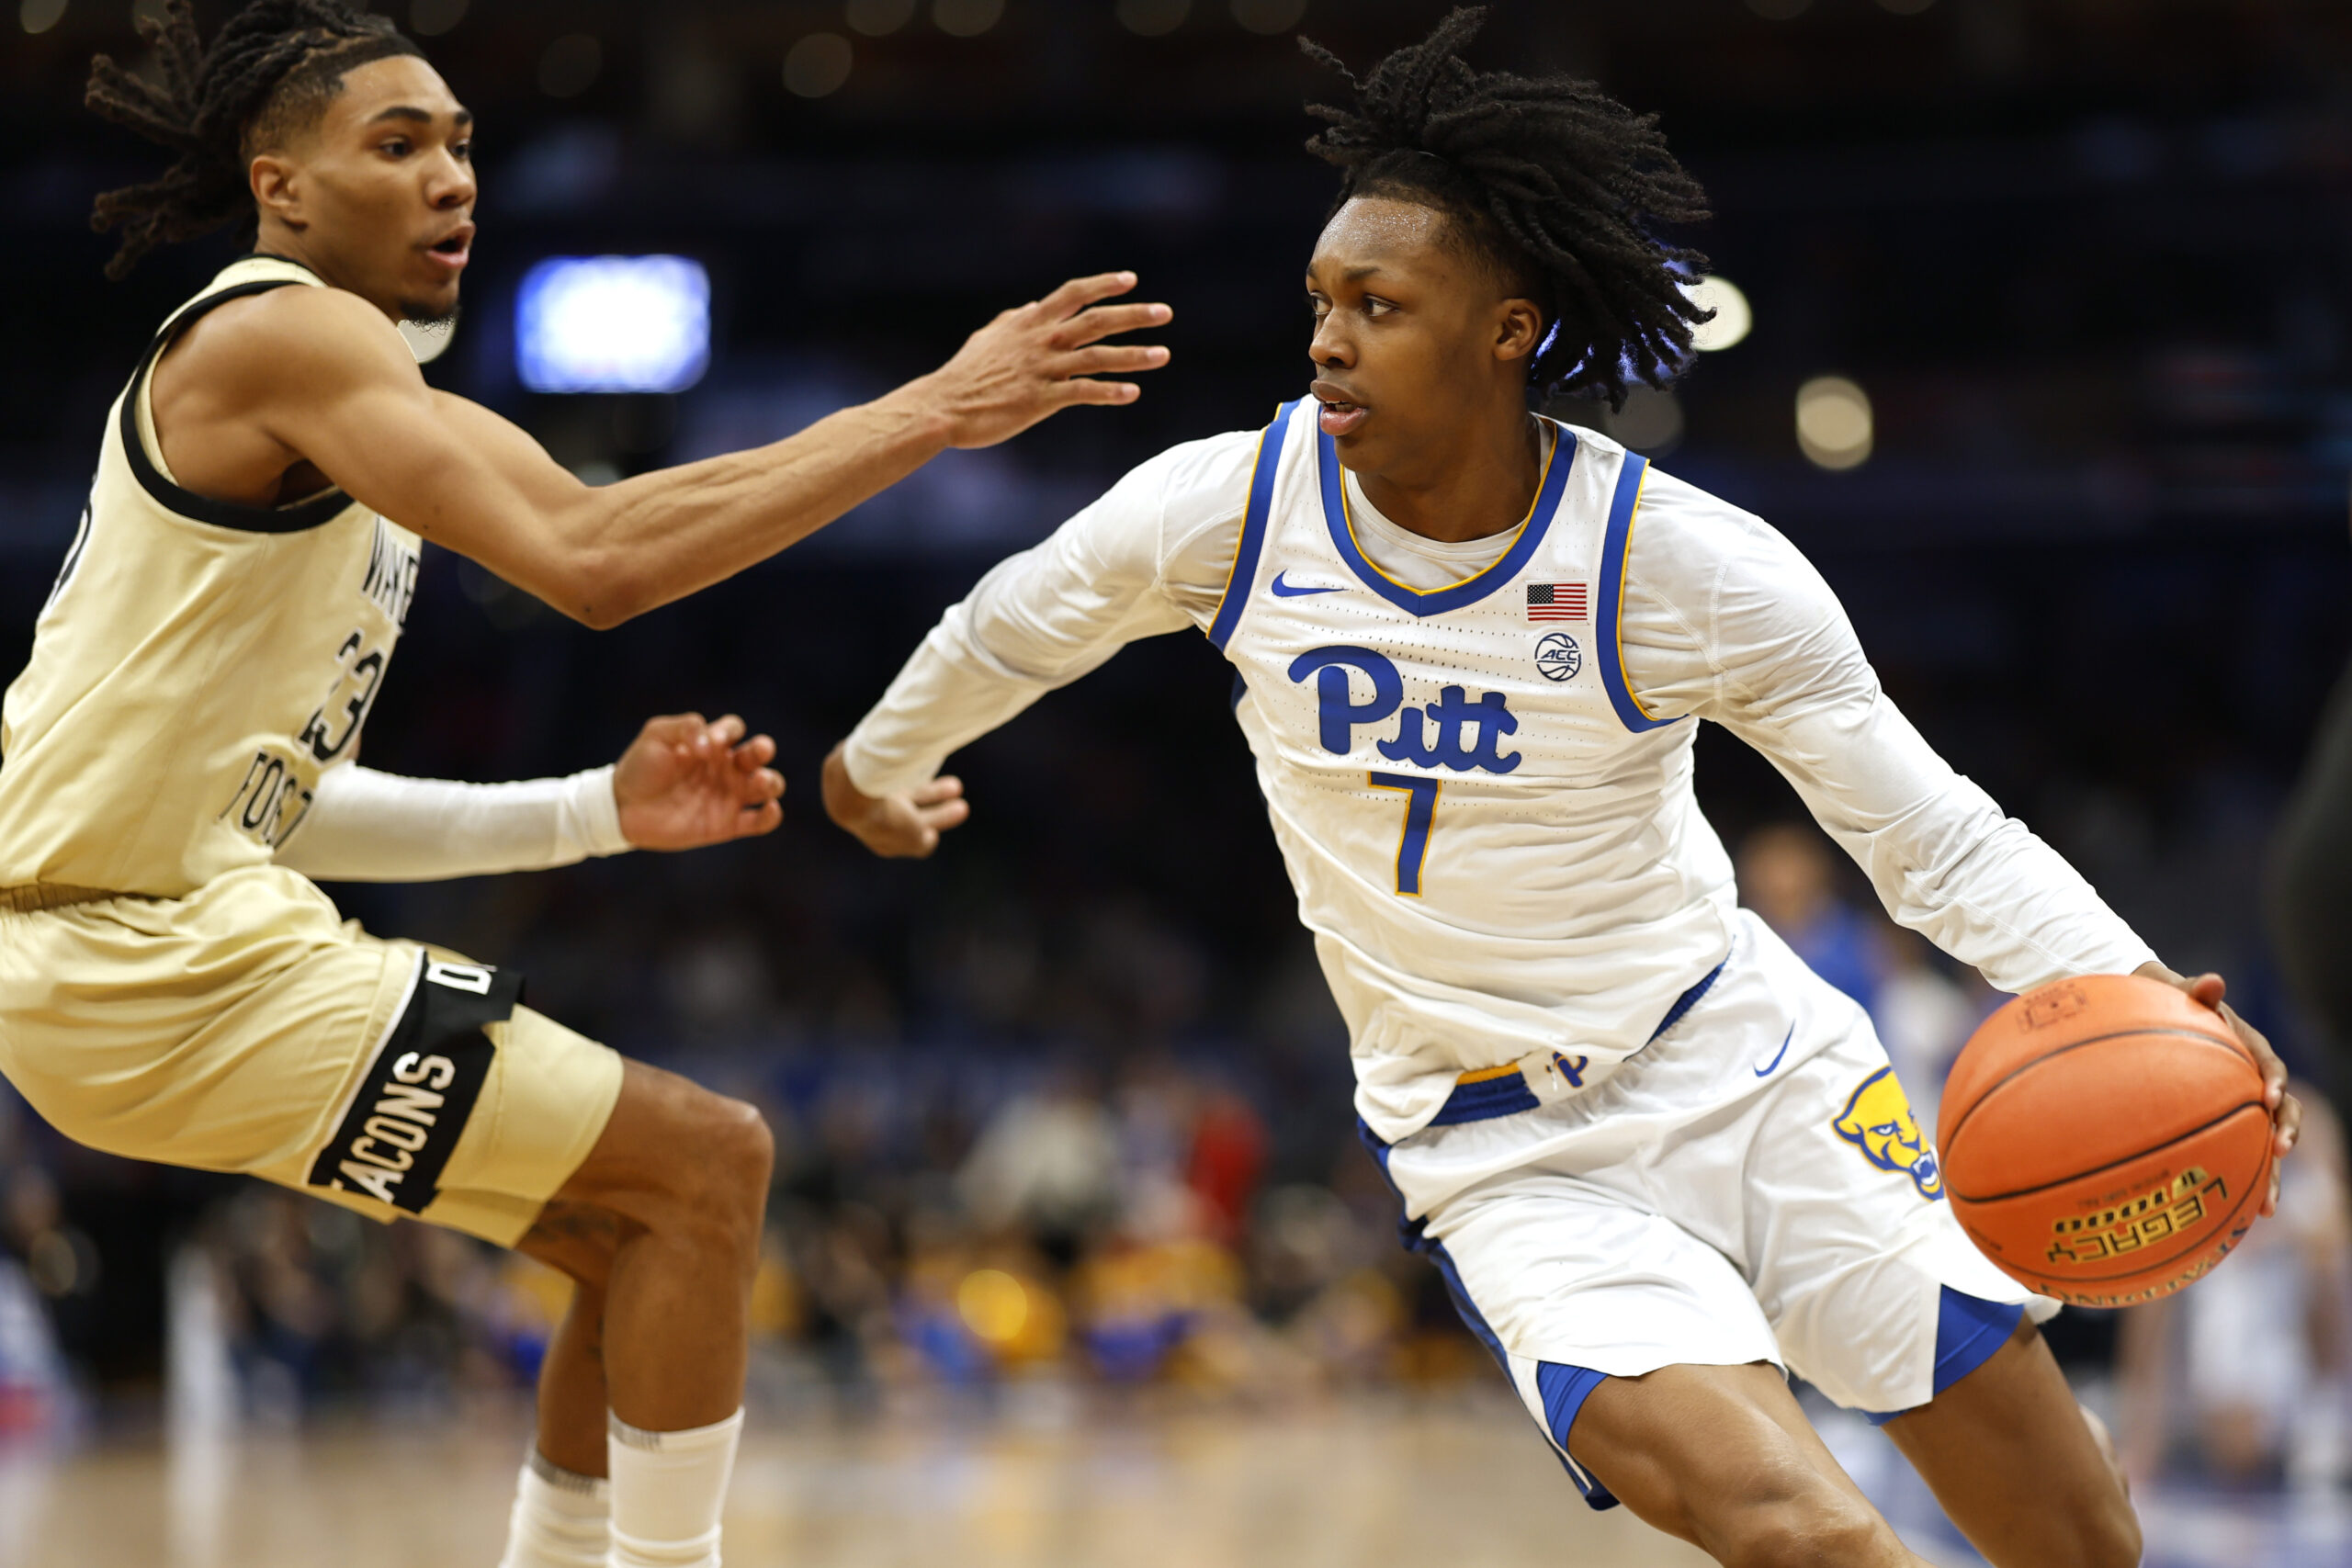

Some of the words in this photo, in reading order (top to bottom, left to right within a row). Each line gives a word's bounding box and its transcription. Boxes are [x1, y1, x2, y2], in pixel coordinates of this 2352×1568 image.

[1288, 645, 1522, 774] Pitt
[1541, 649, 1580, 660] ACC
[1366, 770, 1442, 898] 7
[330, 1051, 456, 1203] ACONS
[2045, 1174, 2228, 1264] LEGACY
